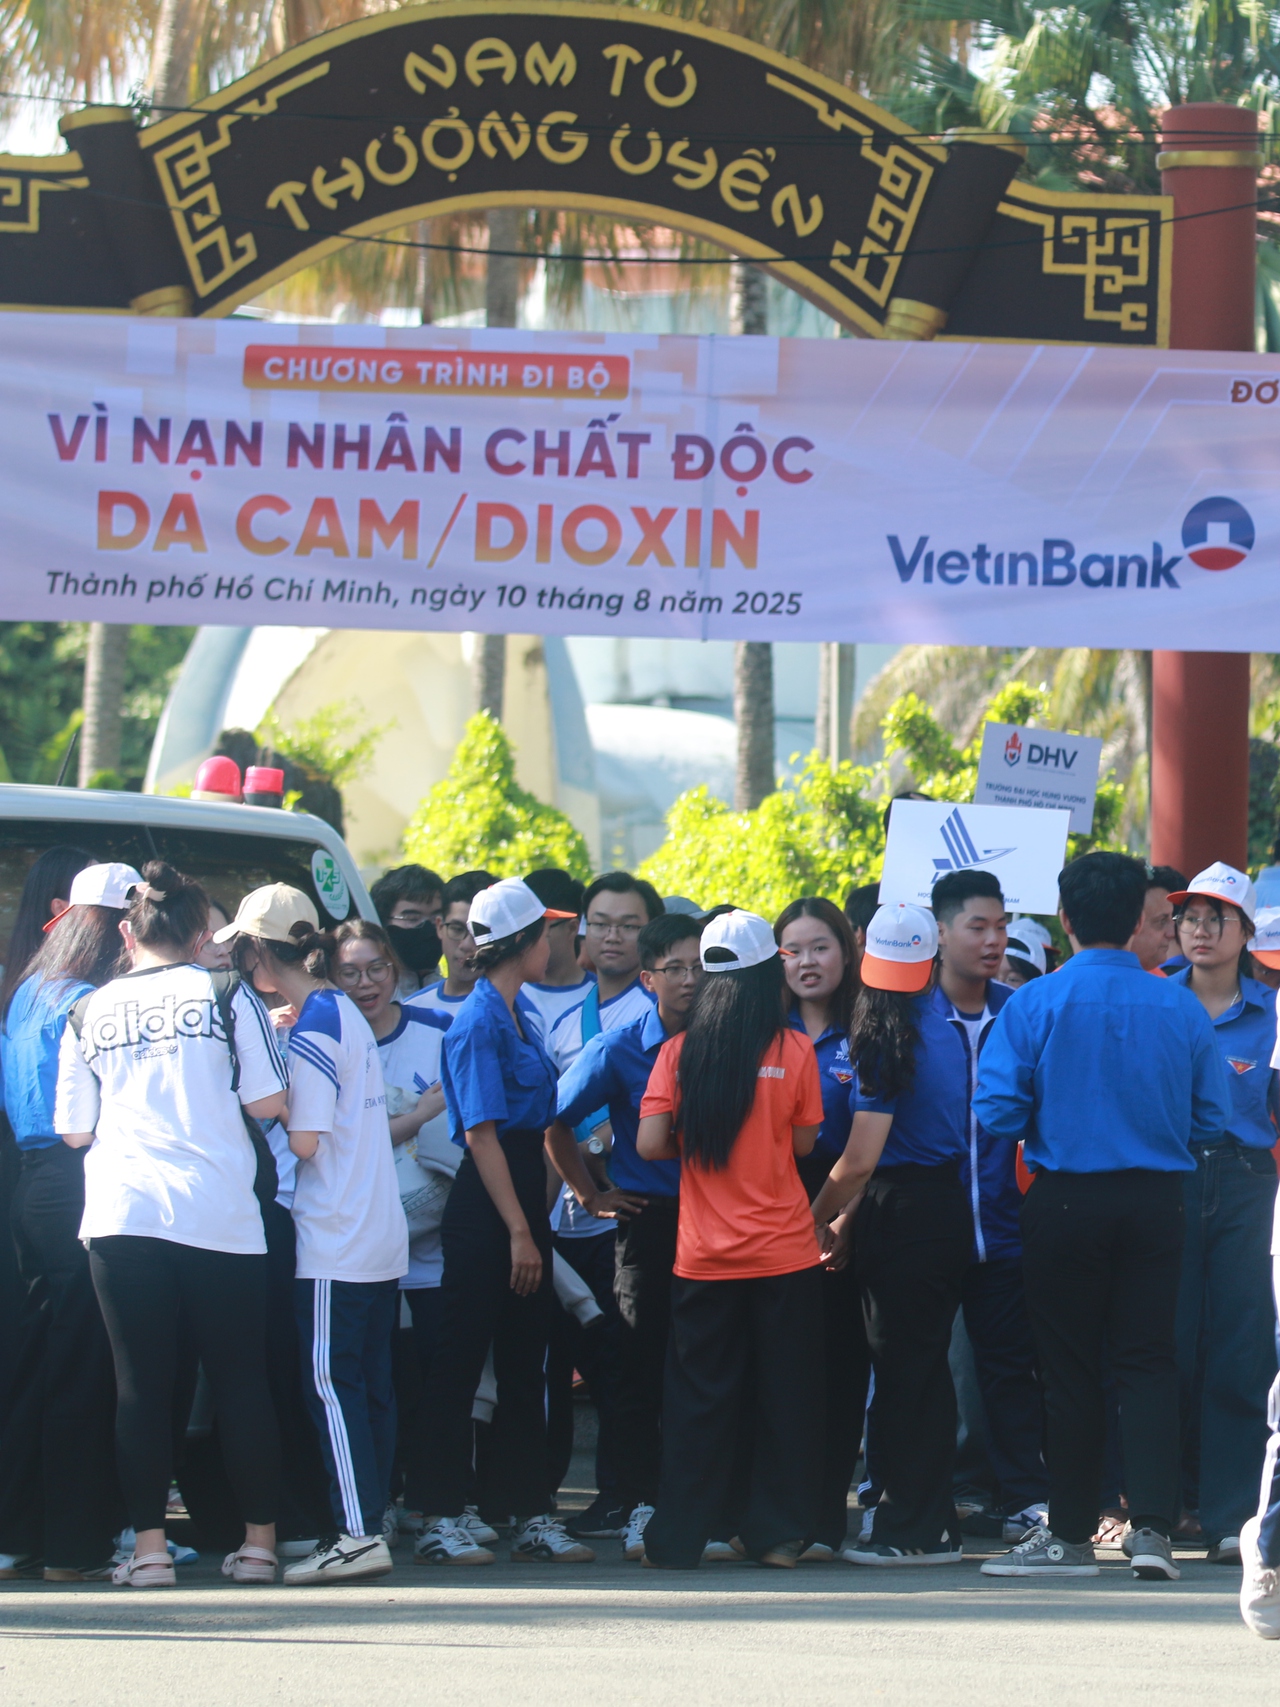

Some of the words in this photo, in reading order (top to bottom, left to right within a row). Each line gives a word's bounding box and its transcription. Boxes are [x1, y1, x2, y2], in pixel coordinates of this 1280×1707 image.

[404, 37, 577, 95] NAM
[602, 43, 697, 107] TÚ
[609, 122, 824, 237] UYỂN
[263, 356, 403, 384] CHƯƠNG
[416, 357, 508, 388] TRÌNH
[521, 364, 554, 388] ĐI
[567, 361, 611, 397] BỘ
[47, 402, 109, 463] VÌ
[132, 417, 264, 481] NẠN
[286, 411, 462, 474] NHÂN
[484, 413, 652, 480] CHẤT
[670, 422, 816, 498] ĐỘC
[97, 490, 208, 554] DA
[236, 493, 760, 570] CAM/DIOXIN
[886, 535, 1184, 589] VietinBank
[47, 571, 137, 596] Thành
[146, 573, 208, 603] phố
[214, 575, 255, 600] Hồ
[264, 578, 314, 602] Chí
[322, 579, 399, 609] Minh,
[410, 583, 486, 613] ngày
[496, 585, 527, 608] 10
[537, 587, 625, 617] tháng
[634, 588, 651, 612] 8
[660, 590, 723, 614] năm
[732, 591, 803, 616] 2025
[1027, 744, 1078, 770] DHV
[875, 936, 912, 948] VietinBank
